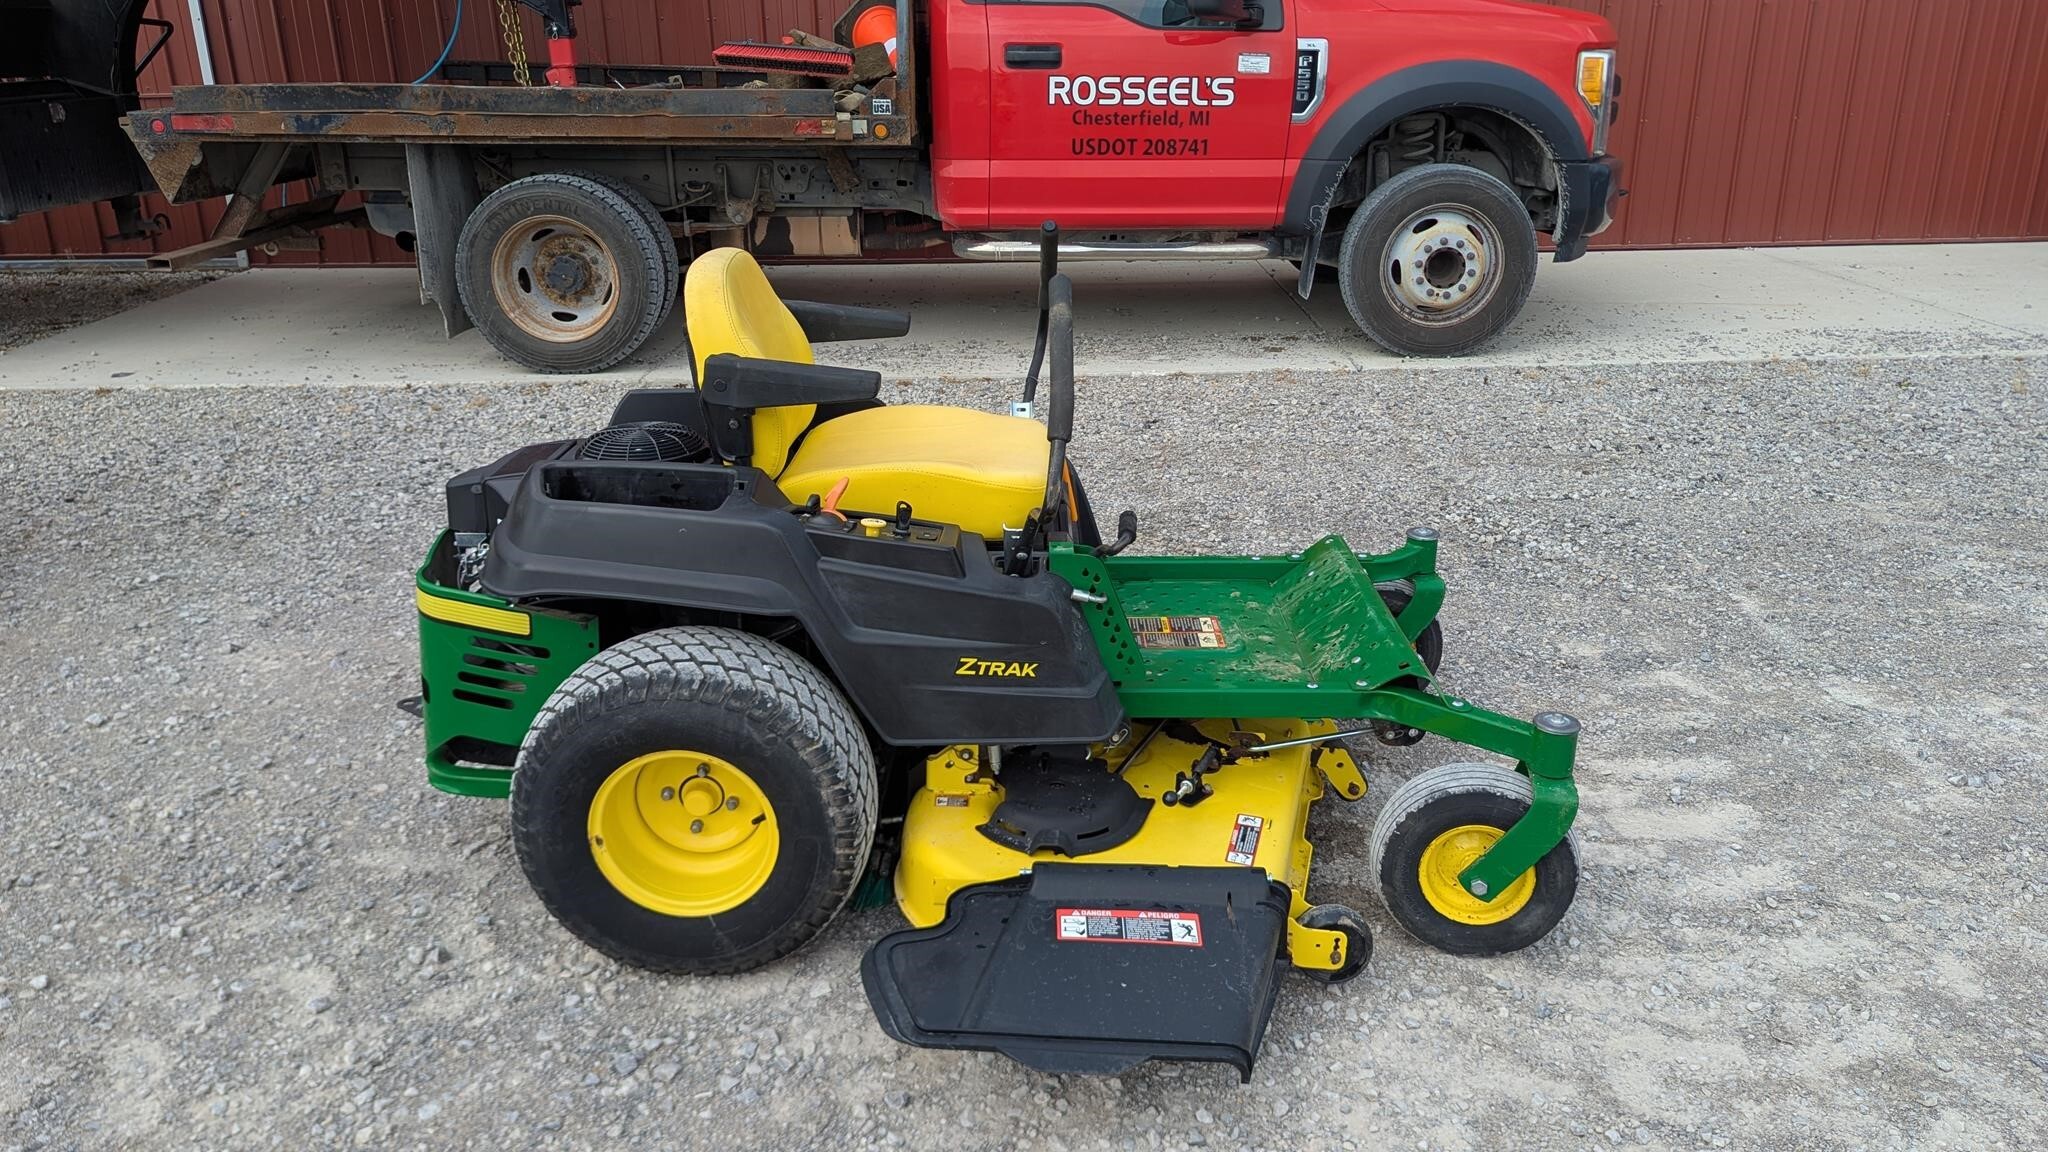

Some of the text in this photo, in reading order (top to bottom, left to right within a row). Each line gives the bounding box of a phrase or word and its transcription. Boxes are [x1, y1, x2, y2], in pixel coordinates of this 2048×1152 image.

[1048, 75, 1236, 107] ROSSEEL'S
[873, 104, 891, 113] USA
[1072, 109, 1210, 128] Chesterfield, MI
[1071, 138, 1209, 156] USDOT 208741
[1147, 911, 1180, 919] PELIGRO
